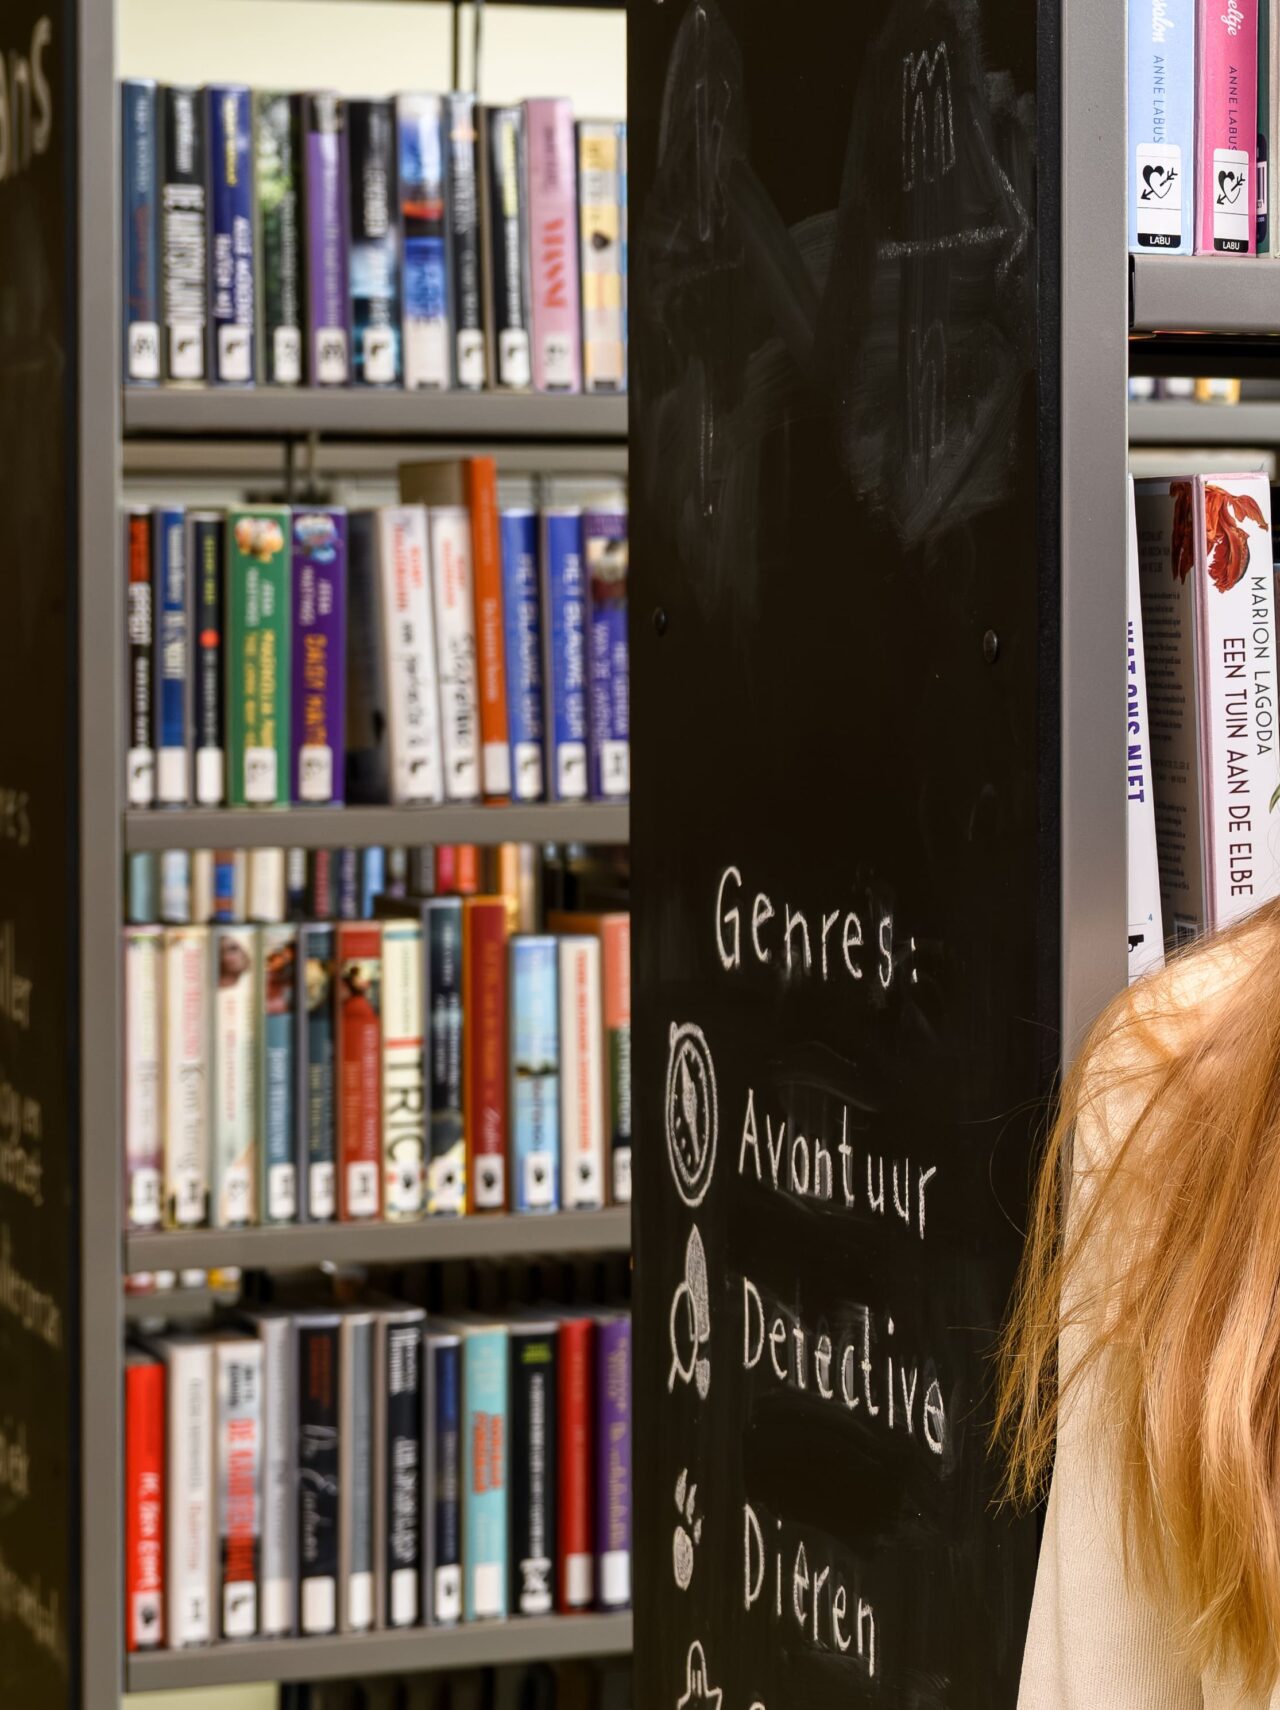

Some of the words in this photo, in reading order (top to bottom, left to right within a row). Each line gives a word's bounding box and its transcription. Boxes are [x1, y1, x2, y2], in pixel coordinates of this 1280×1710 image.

[1153, 55, 1166, 94] ANNE
[1229, 66, 1239, 104] ANNE
[1153, 99, 1166, 143] LABUS
[1150, 236, 1171, 246] LABU
[1222, 241, 1240, 250] LABU
[1250, 576, 1270, 659] MARION
[1223, 638, 1247, 680] EEN
[1225, 688, 1249, 739] TUIN
[1254, 671, 1273, 755] LAGODA
[1226, 750, 1251, 794] AAN
[1228, 805, 1251, 833] DE
[1230, 843, 1254, 896] ELBE
[715, 865, 918, 989] Genres:
[738, 1087, 938, 1240] Avontuur
[744, 1276, 945, 1455] Detective
[744, 1502, 876, 1678] Dieren
